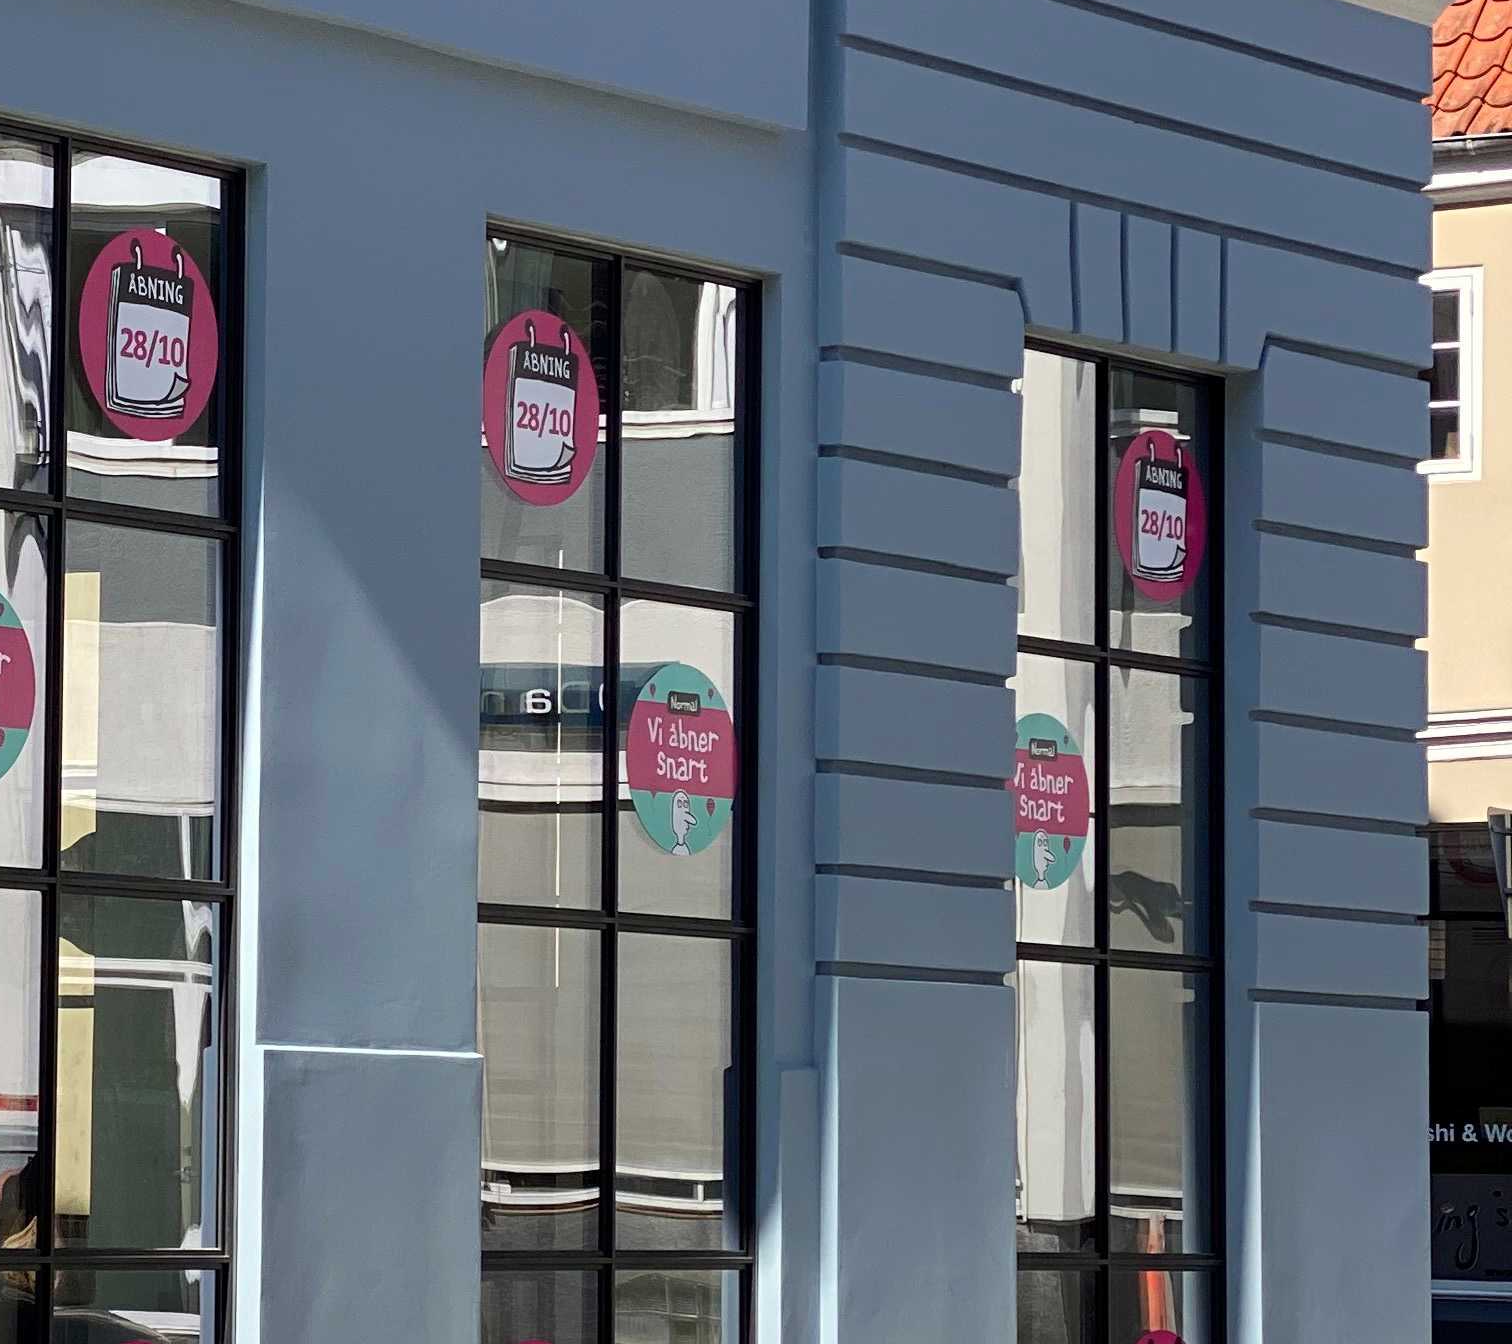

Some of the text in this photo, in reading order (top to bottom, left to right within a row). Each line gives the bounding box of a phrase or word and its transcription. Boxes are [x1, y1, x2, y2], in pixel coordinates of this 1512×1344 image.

[128, 273, 183, 304] ÅBNING
[120, 327, 185, 368] 28/10
[523, 350, 570, 379] ÅBNING
[516, 401, 571, 438] 28/10
[1141, 509, 1183, 541] 28/10
[670, 696, 698, 713] Normal
[648, 717, 719, 752] Vi åbner
[1030, 764, 1074, 795] åbner
[1462, 1123, 1479, 1142] &
